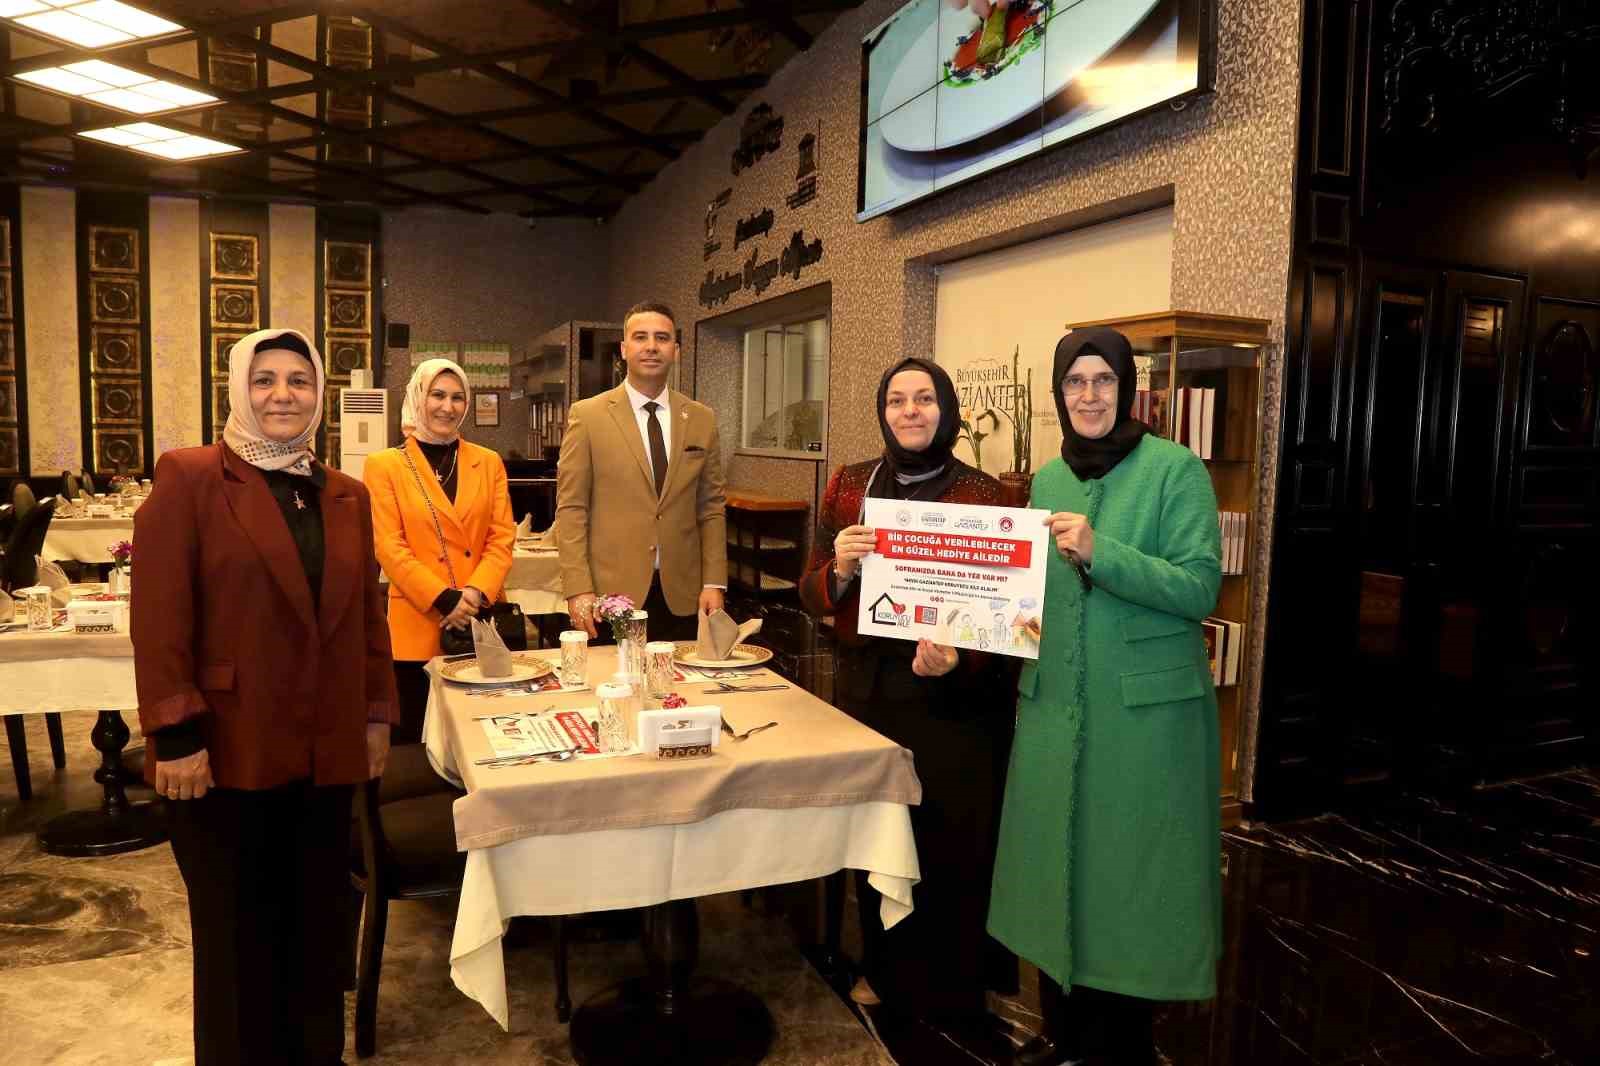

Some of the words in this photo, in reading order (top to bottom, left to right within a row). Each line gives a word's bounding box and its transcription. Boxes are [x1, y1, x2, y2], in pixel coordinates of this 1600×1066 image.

[957, 364, 1010, 384] BÜYÜKŞEHİR
[954, 383, 1026, 411] ZİANTEP
[887, 533, 902, 542] BİR
[904, 534, 942, 546] ÇOCUĞA
[944, 536, 1016, 553] VERİLEBİLECEK
[891, 545, 904, 554] EN
[905, 545, 935, 558] GÜZEL
[937, 548, 971, 560] HEDİYE
[972, 550, 1010, 564] AİLEDİR
[957, 570, 967, 579] DA
[967, 571, 981, 580] YER
[982, 573, 996, 582] VAR
